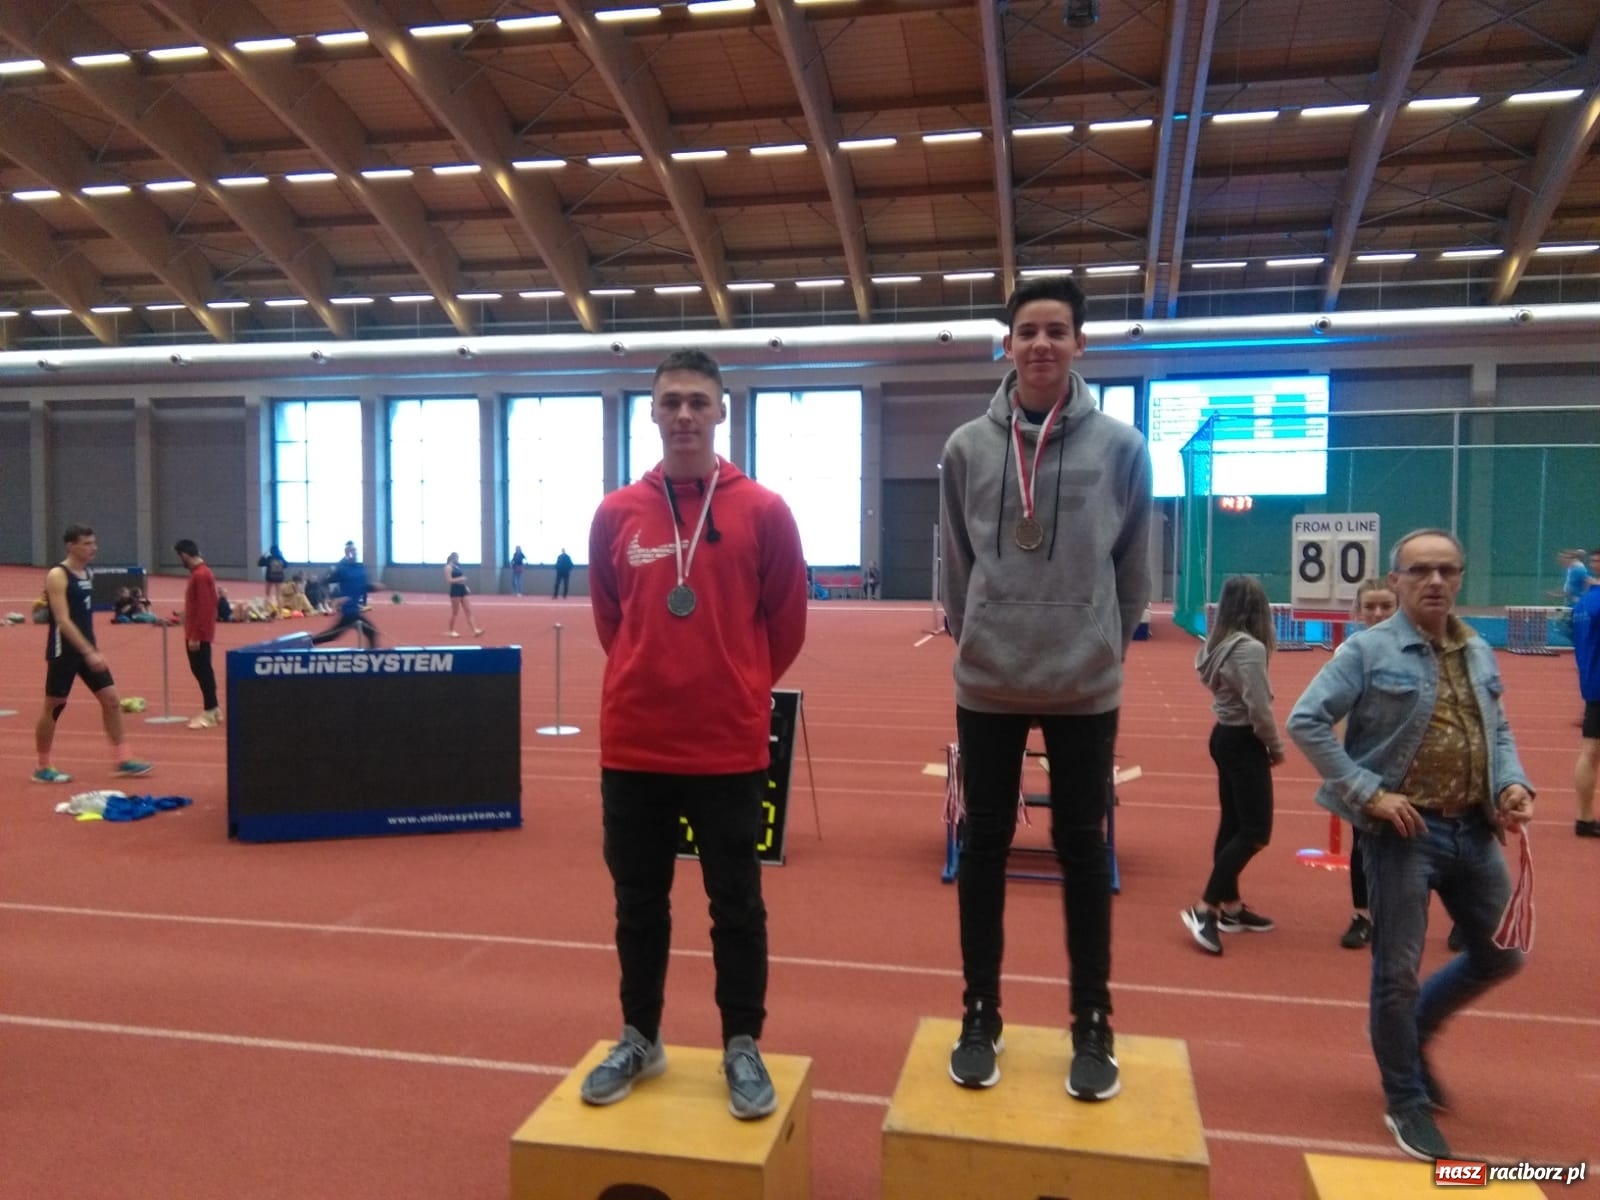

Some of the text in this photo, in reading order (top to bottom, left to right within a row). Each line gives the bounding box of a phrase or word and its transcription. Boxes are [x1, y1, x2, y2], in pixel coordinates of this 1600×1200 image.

[1295, 521, 1331, 533] FROM
[1347, 520, 1377, 532] LINE
[254, 653, 454, 676] ONLINESYSTEM
